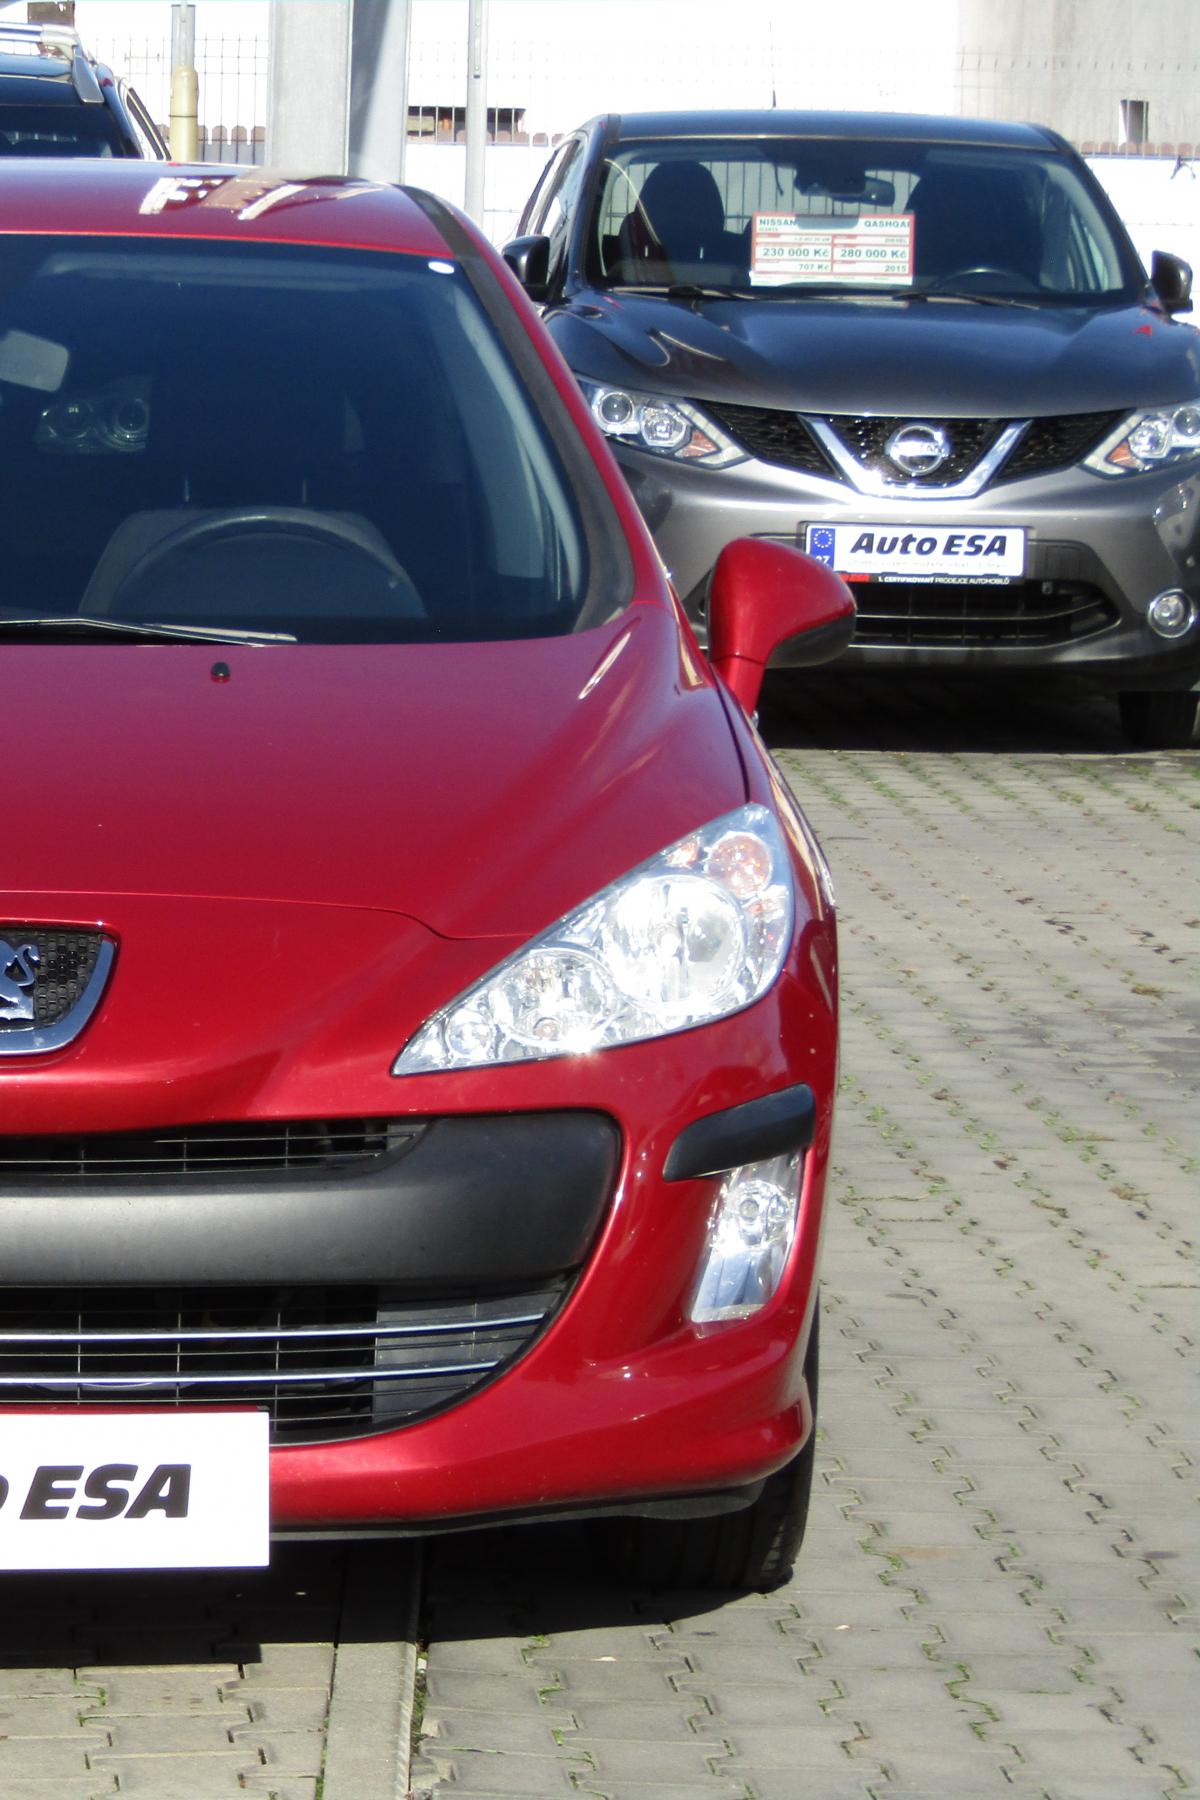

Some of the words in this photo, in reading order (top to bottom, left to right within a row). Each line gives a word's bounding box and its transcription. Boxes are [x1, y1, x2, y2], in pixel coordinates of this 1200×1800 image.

[759, 218, 798, 226] NISSAN
[864, 220, 910, 228] QASHQAI
[762, 248, 784, 257] 230
[788, 248, 810, 257] 000
[814, 248, 830, 257] Kč
[840, 249, 862, 258] 280
[865, 249, 887, 258] 000
[891, 249, 907, 258] Kč
[885, 264, 907, 272] 2015
[850, 532, 938, 556] Auto
[942, 534, 1007, 556] ESA
[19, 1463, 192, 1520] ESA
